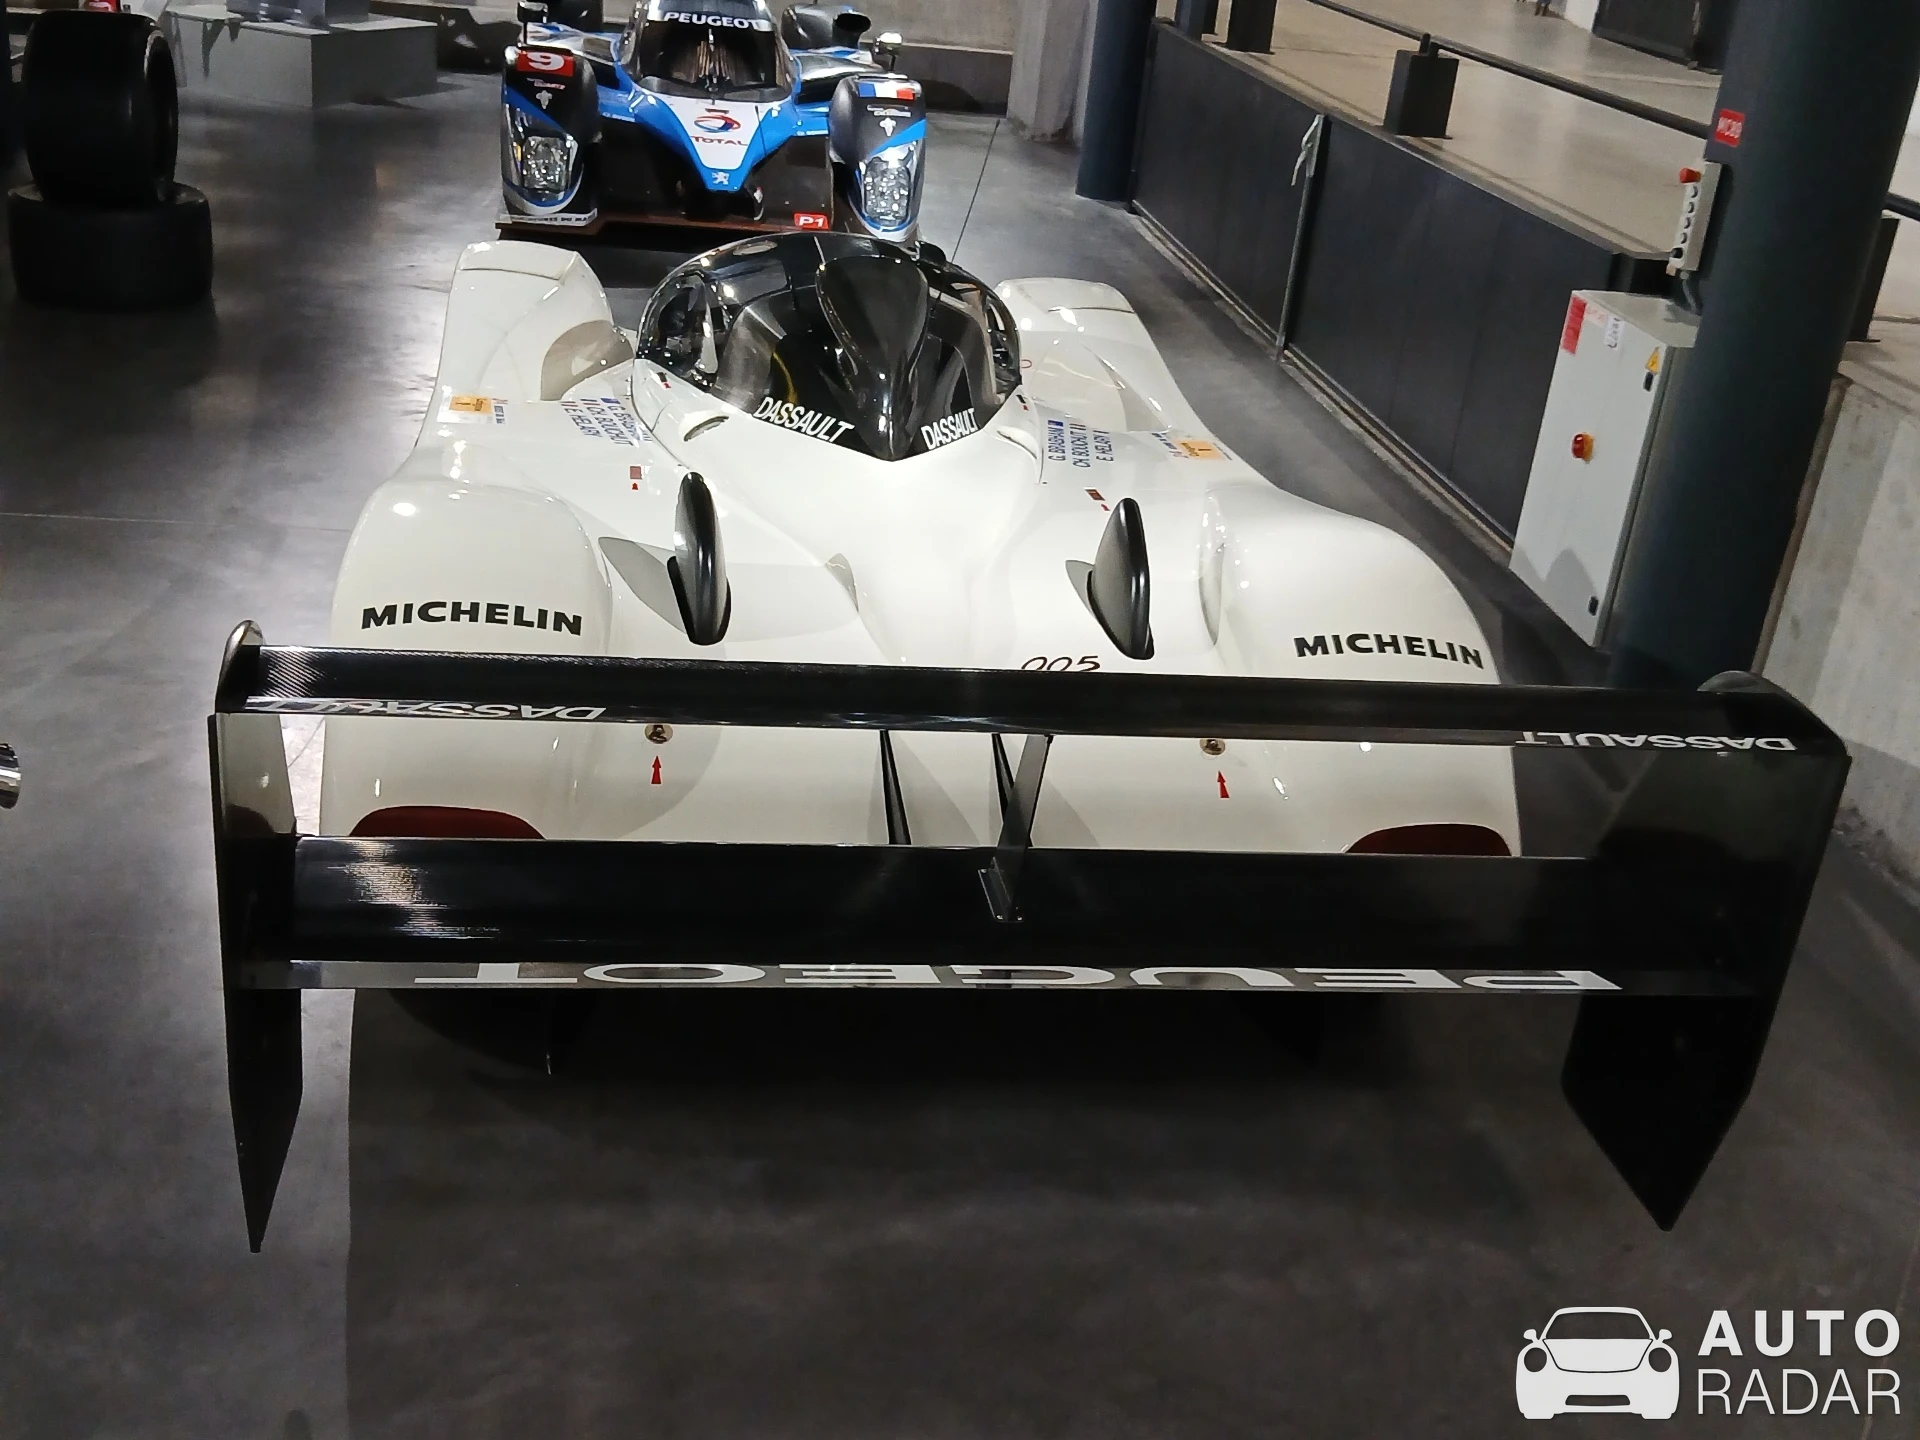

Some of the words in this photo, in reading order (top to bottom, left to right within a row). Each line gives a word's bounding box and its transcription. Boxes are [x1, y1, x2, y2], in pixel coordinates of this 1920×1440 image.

[664, 12, 762, 31] PEUGEOT
[526, 52, 565, 71] 9
[690, 135, 748, 146] TOTAL
[799, 216, 824, 228] P1
[752, 397, 855, 443] DASSAULT
[921, 408, 979, 450] DASSAULT
[361, 601, 582, 636] MICHELIN
[1293, 633, 1484, 669] MICHELIN
[1515, 731, 1798, 751] DASSAULT
[415, 962, 1623, 991] PEUGEOT
